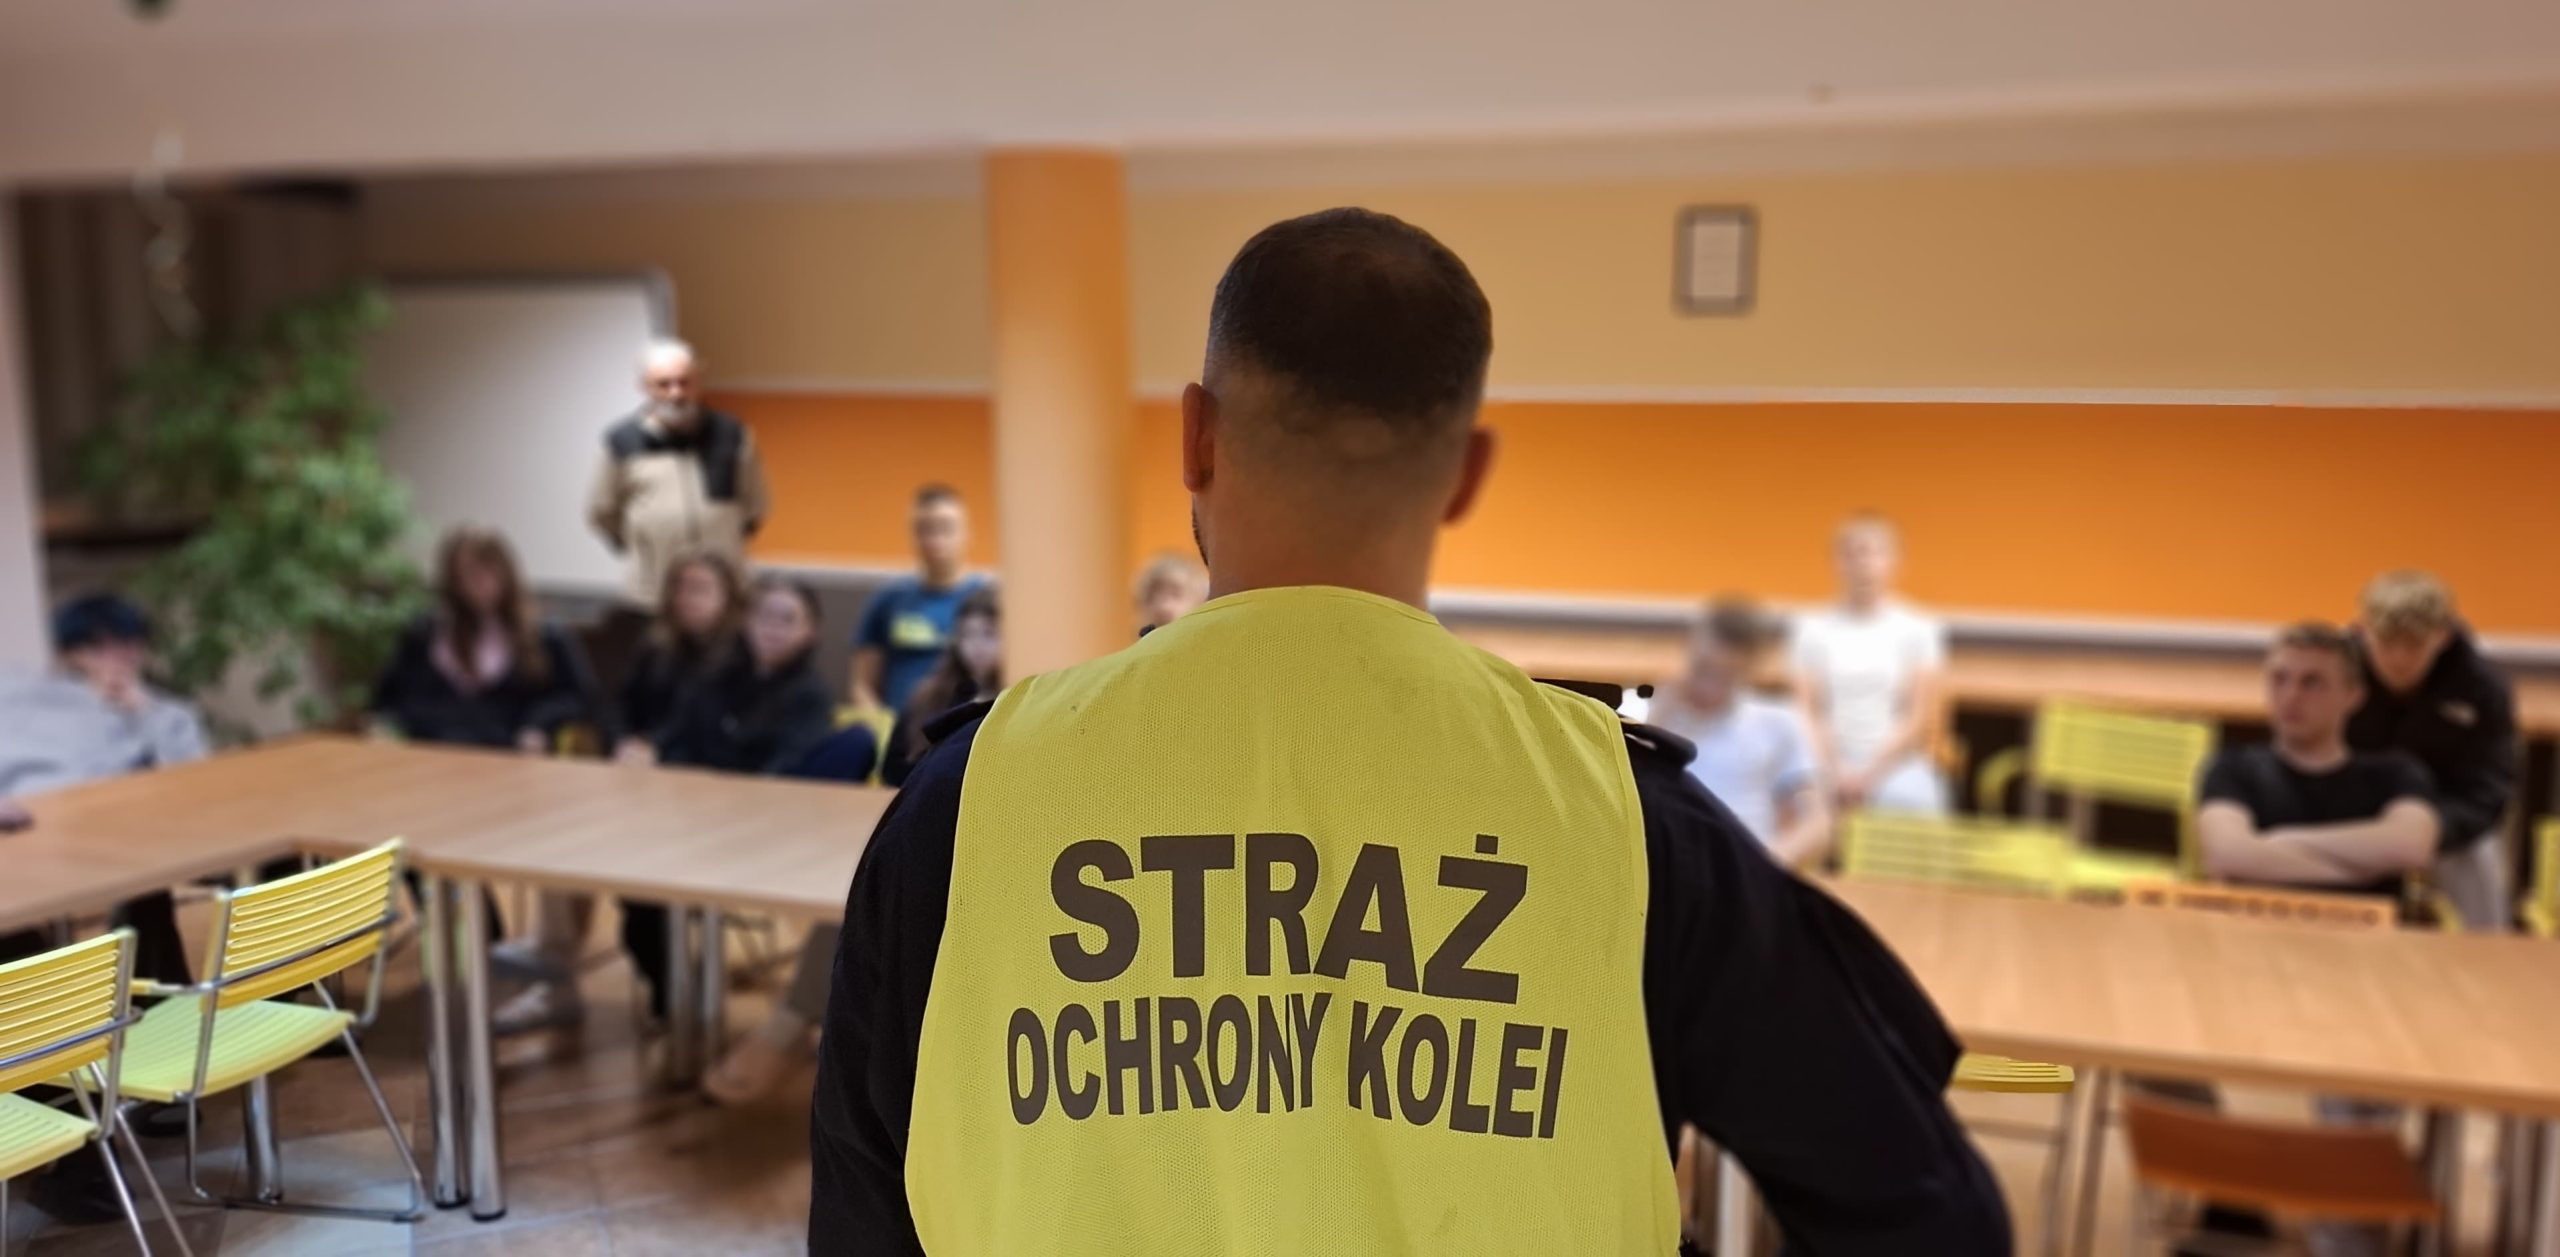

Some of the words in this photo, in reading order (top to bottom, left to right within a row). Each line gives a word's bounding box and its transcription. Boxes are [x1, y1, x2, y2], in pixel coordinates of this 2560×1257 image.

[1048, 832, 1529, 1006] STRAŻ
[1006, 991, 1333, 1126] OCHRONY
[1347, 1000, 1569, 1140] KOLEI
